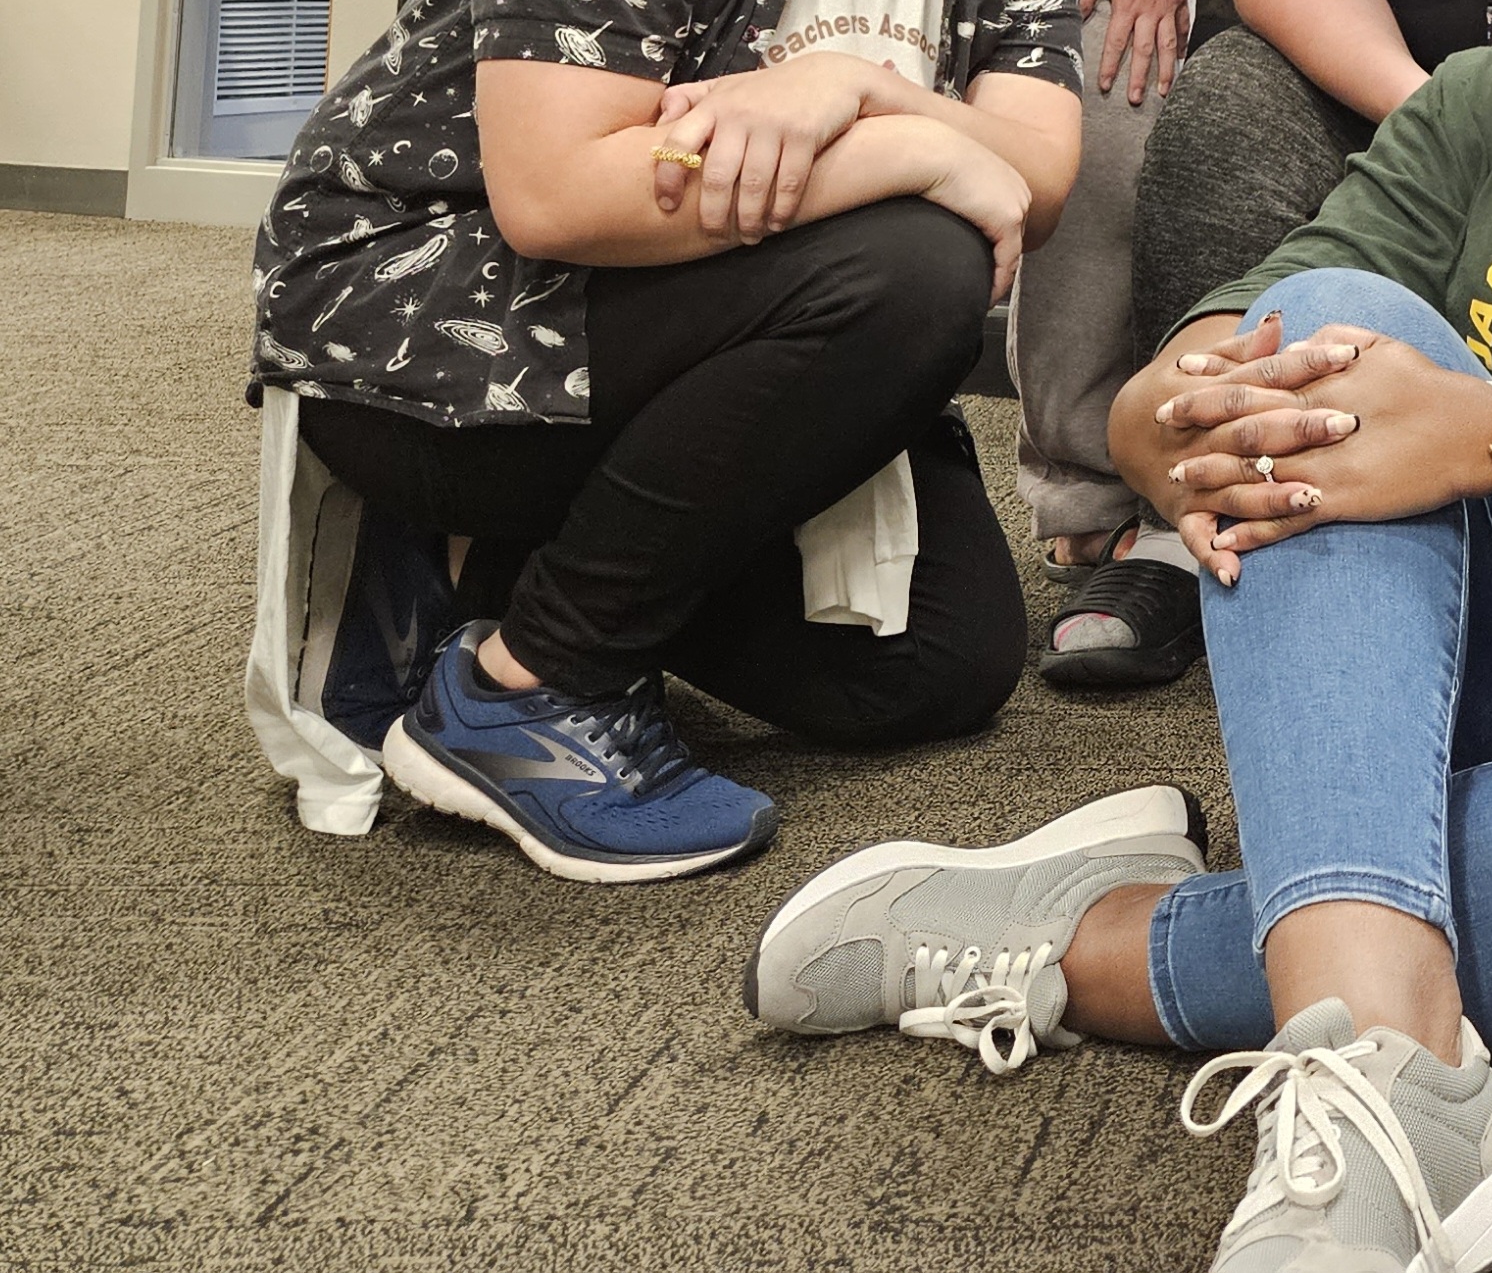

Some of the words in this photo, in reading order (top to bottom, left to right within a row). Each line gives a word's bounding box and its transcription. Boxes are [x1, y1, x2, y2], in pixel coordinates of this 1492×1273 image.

[768, 14, 870, 64] eachers
[878, 13, 939, 62] Assoc
[565, 754, 597, 777] BROOKS
